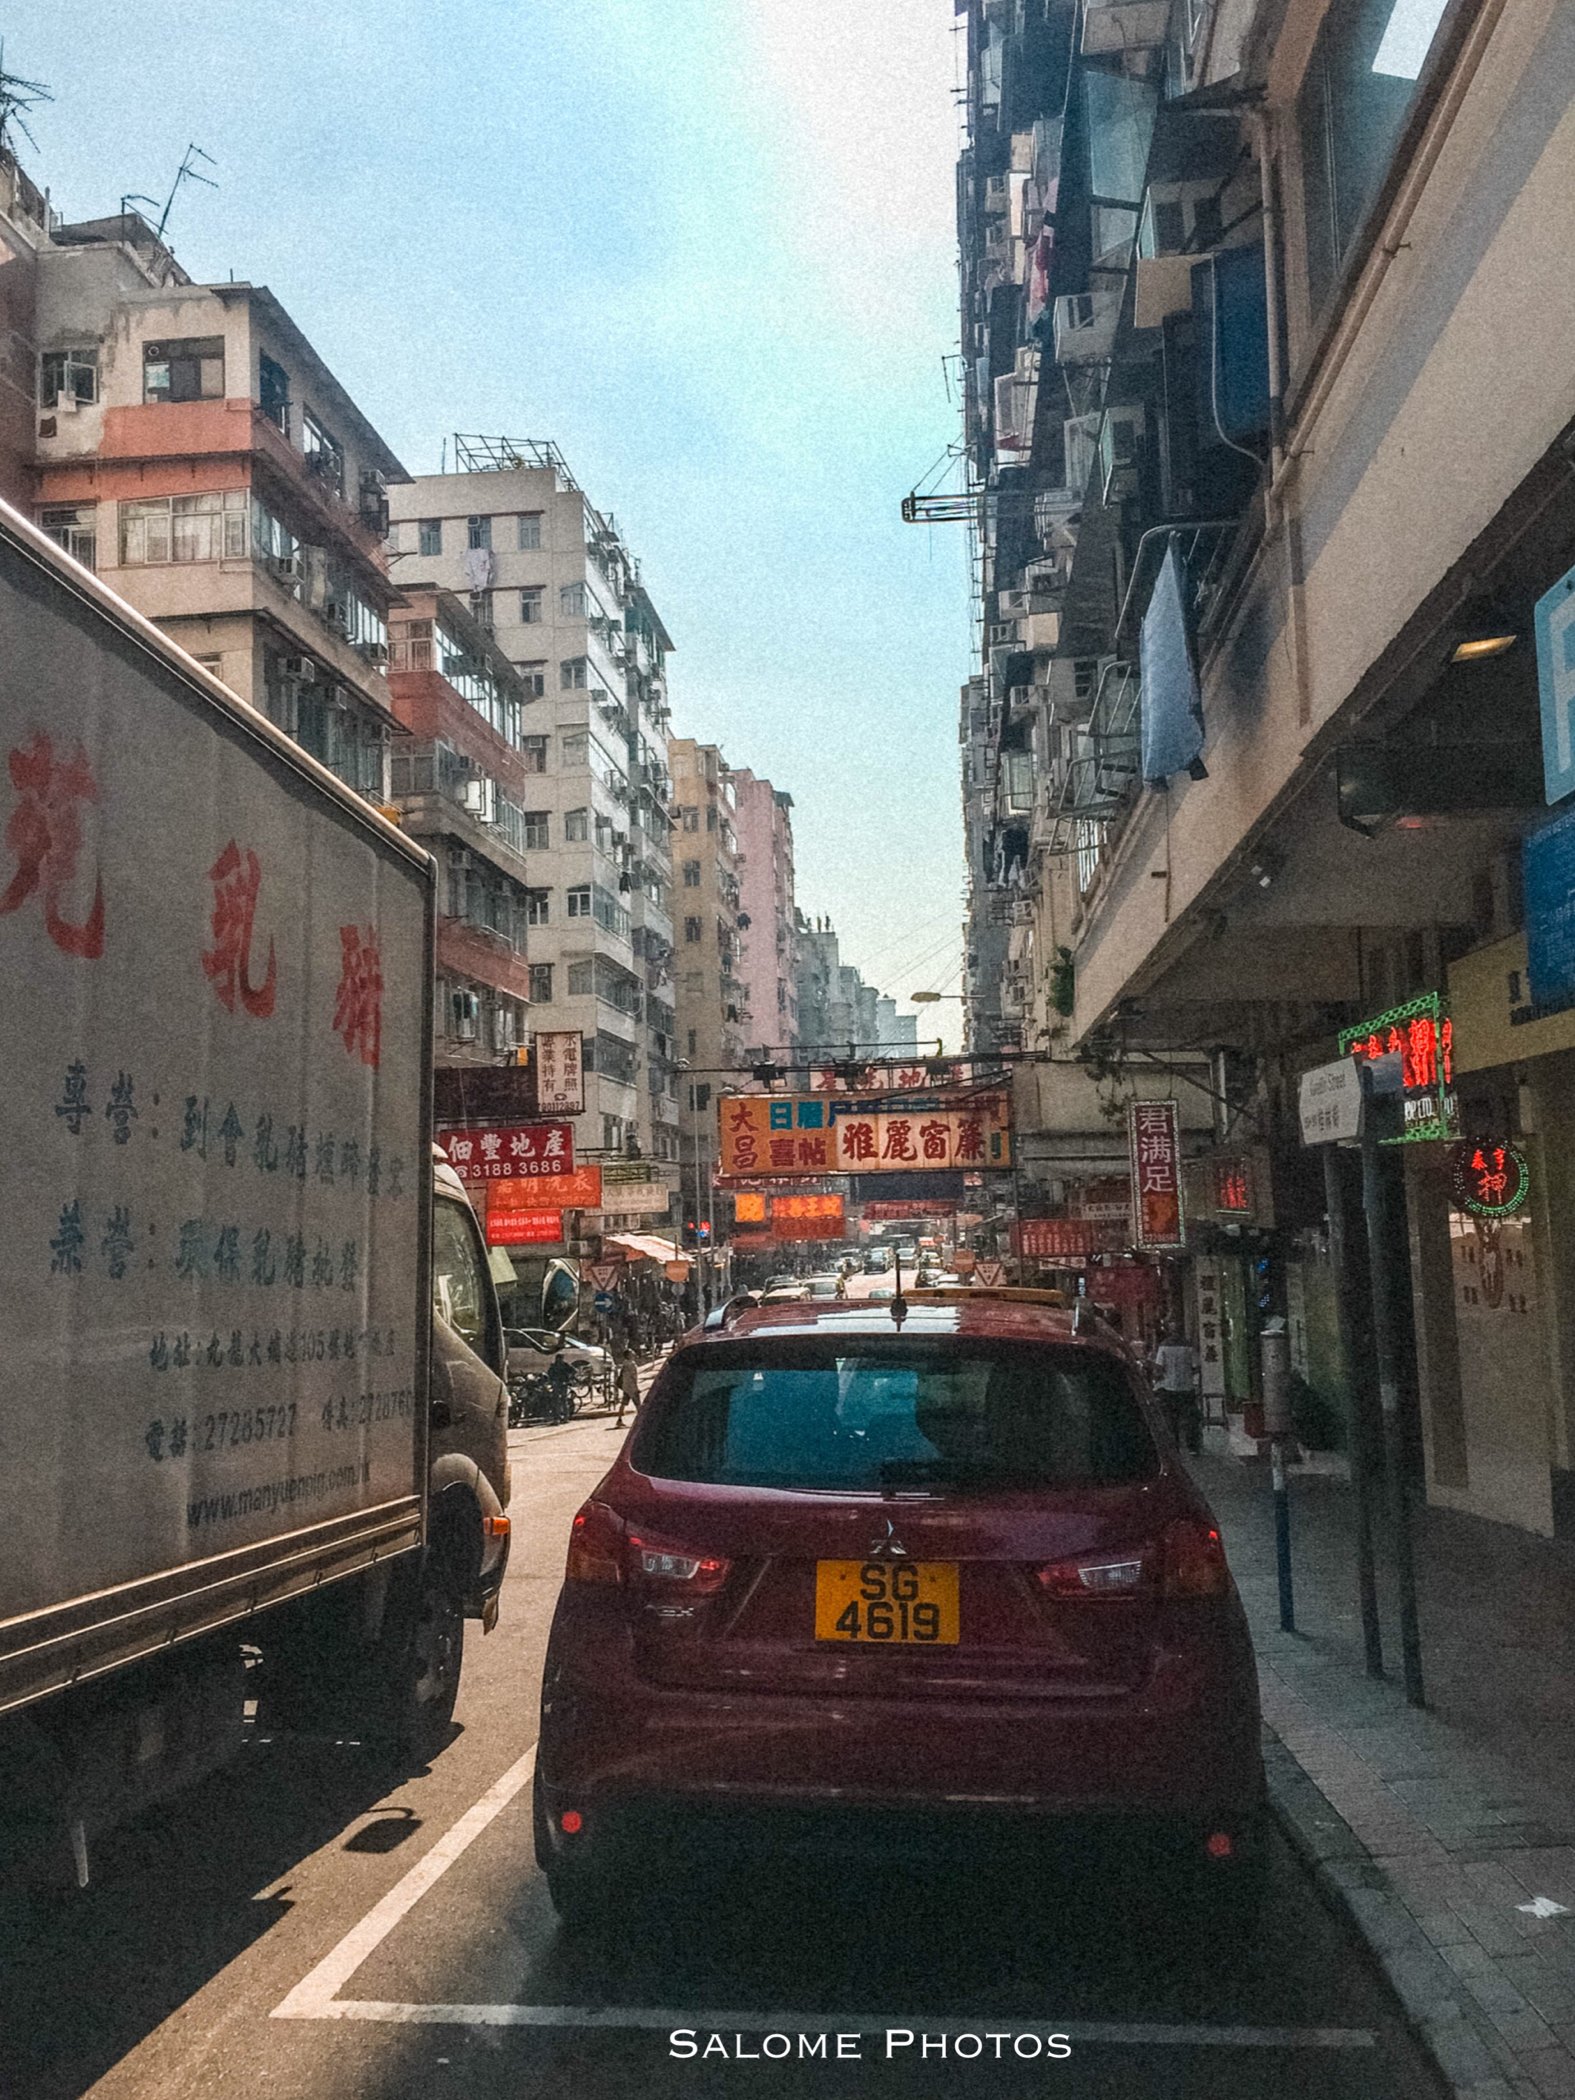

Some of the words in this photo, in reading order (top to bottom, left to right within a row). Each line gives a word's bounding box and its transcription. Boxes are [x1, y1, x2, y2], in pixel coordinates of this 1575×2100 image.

[729, 1101, 760, 1169] 大昌
[842, 1117, 987, 1161] 雅麗窗簾
[472, 1162, 513, 1178] 3188
[518, 1160, 562, 1175] 3686
[860, 1563, 919, 1601] SG
[835, 1600, 940, 1641] 4619
